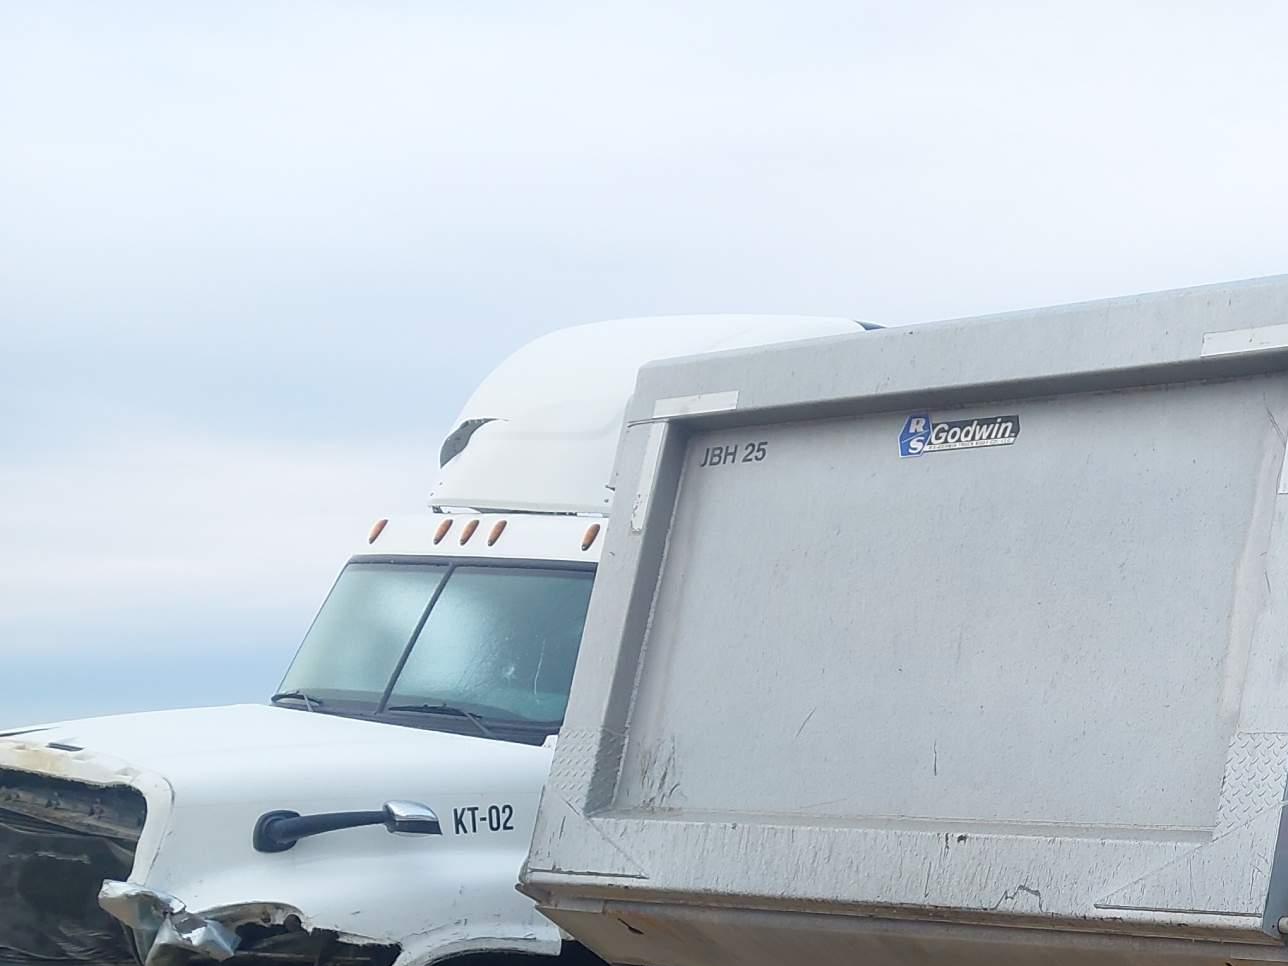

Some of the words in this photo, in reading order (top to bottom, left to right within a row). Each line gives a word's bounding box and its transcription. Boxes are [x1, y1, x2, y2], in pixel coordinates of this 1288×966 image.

[931, 417, 1013, 445] Godwin
[700, 444, 738, 468] JBH
[741, 441, 769, 463] 25
[453, 804, 514, 835] KT-02
